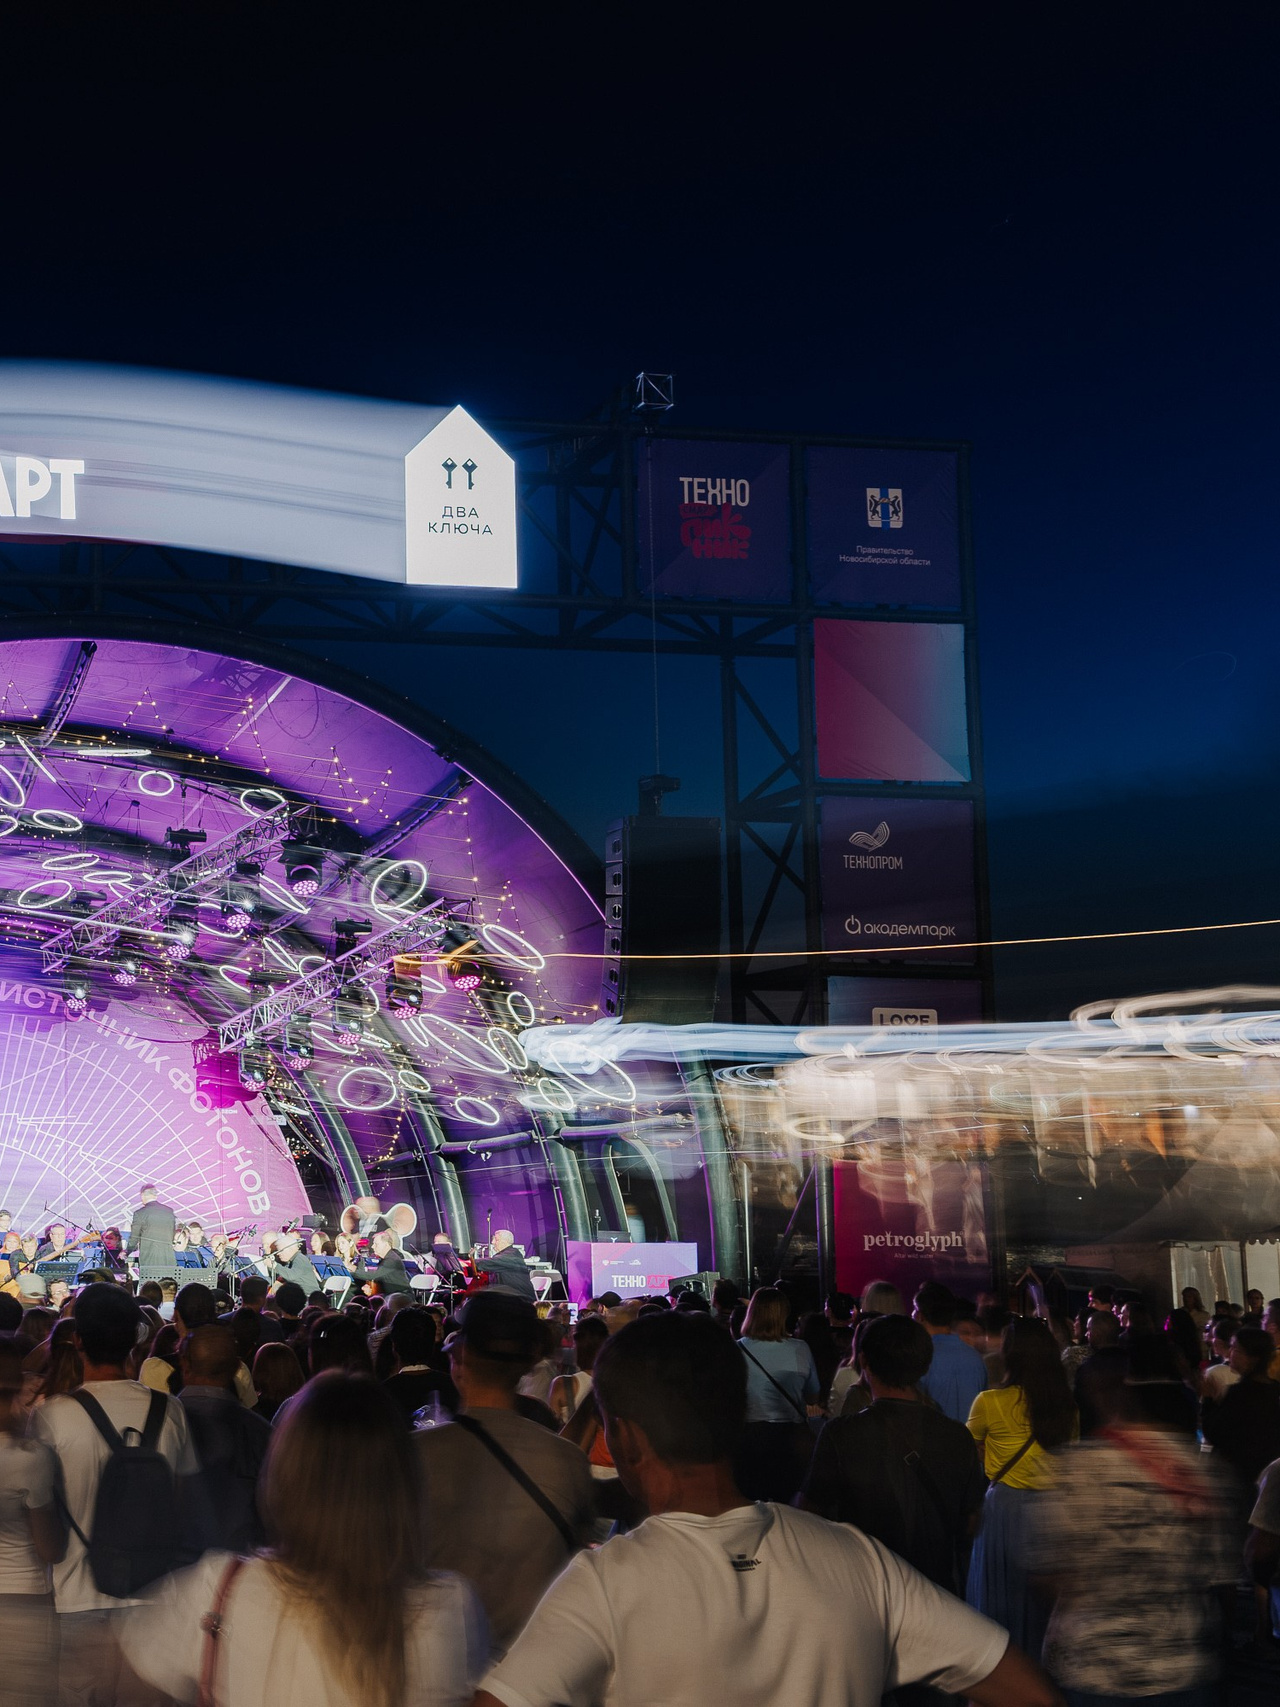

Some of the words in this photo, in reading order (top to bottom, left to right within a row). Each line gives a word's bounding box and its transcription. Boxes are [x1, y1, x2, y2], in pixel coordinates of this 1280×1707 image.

[679, 476, 750, 507] ТЕХНО
[441, 505, 479, 519] ДВА
[428, 521, 493, 536] КЛЮЧА
[856, 545, 914, 556] Правительство
[839, 554, 898, 566] Новосибирской
[899, 557, 931, 566] области
[842, 854, 903, 870] ТЕХНОПРОМ
[863, 922, 956, 941] академпарк
[167, 1067, 271, 1216] ФОТОНОВ
[863, 1231, 963, 1251] petroglyph
[611, 1275, 646, 1288] ТЕХНО
